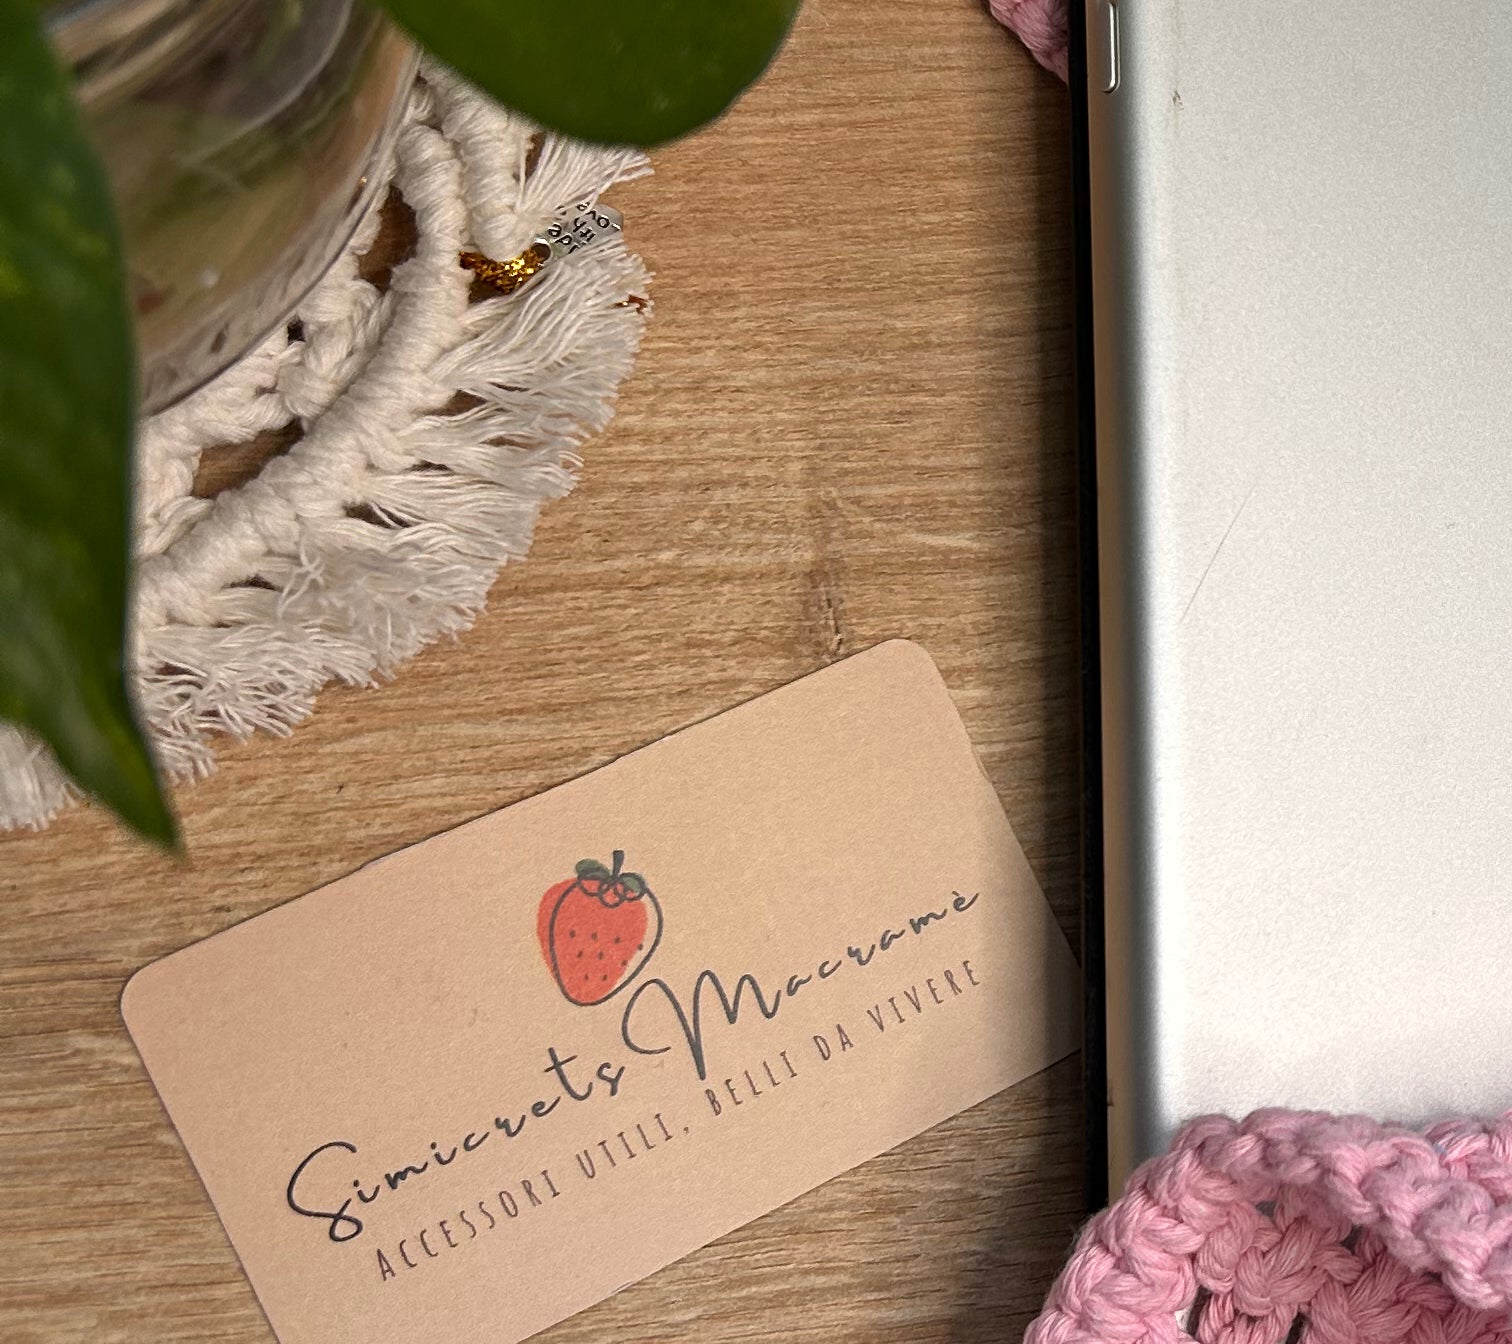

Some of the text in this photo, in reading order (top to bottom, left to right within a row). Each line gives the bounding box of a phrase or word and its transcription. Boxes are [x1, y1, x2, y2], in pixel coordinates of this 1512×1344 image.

[286, 890, 980, 1242] Simicrets Macramè
[374, 959, 983, 1282] ACCESSORI UTILI, BELLI DA VIVERE
